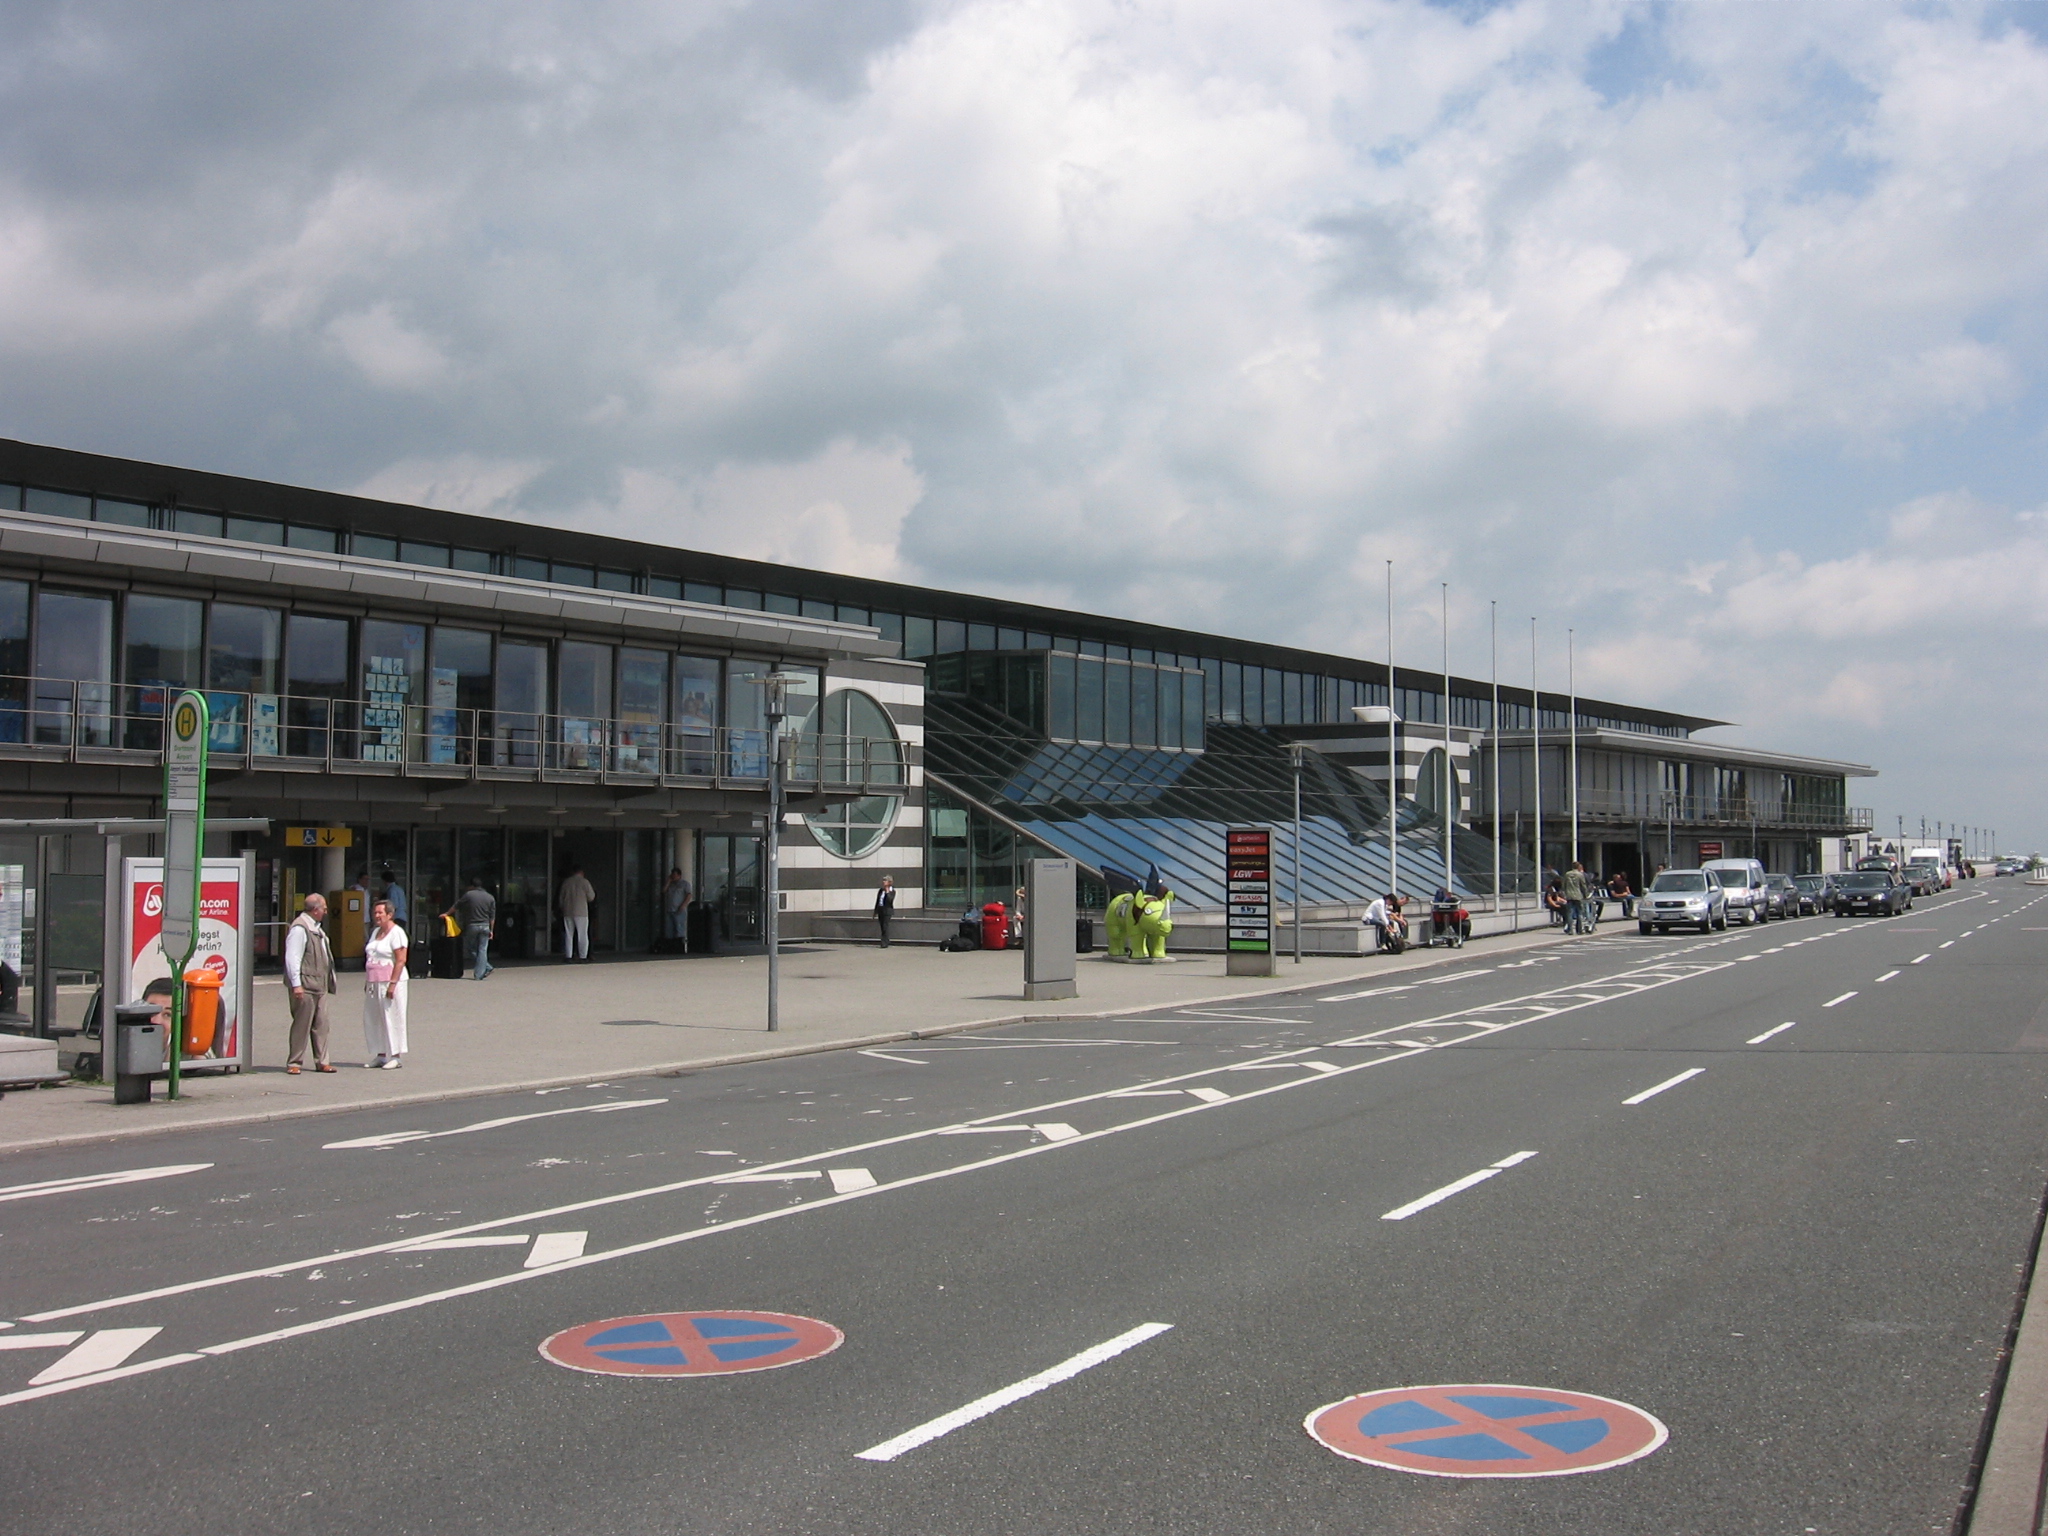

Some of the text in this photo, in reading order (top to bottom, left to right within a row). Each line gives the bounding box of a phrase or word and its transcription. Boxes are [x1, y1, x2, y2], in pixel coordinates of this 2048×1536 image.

[181, 711, 192, 733] H
[1233, 870, 1253, 878] LGW
[197, 941, 222, 951] erlin?
